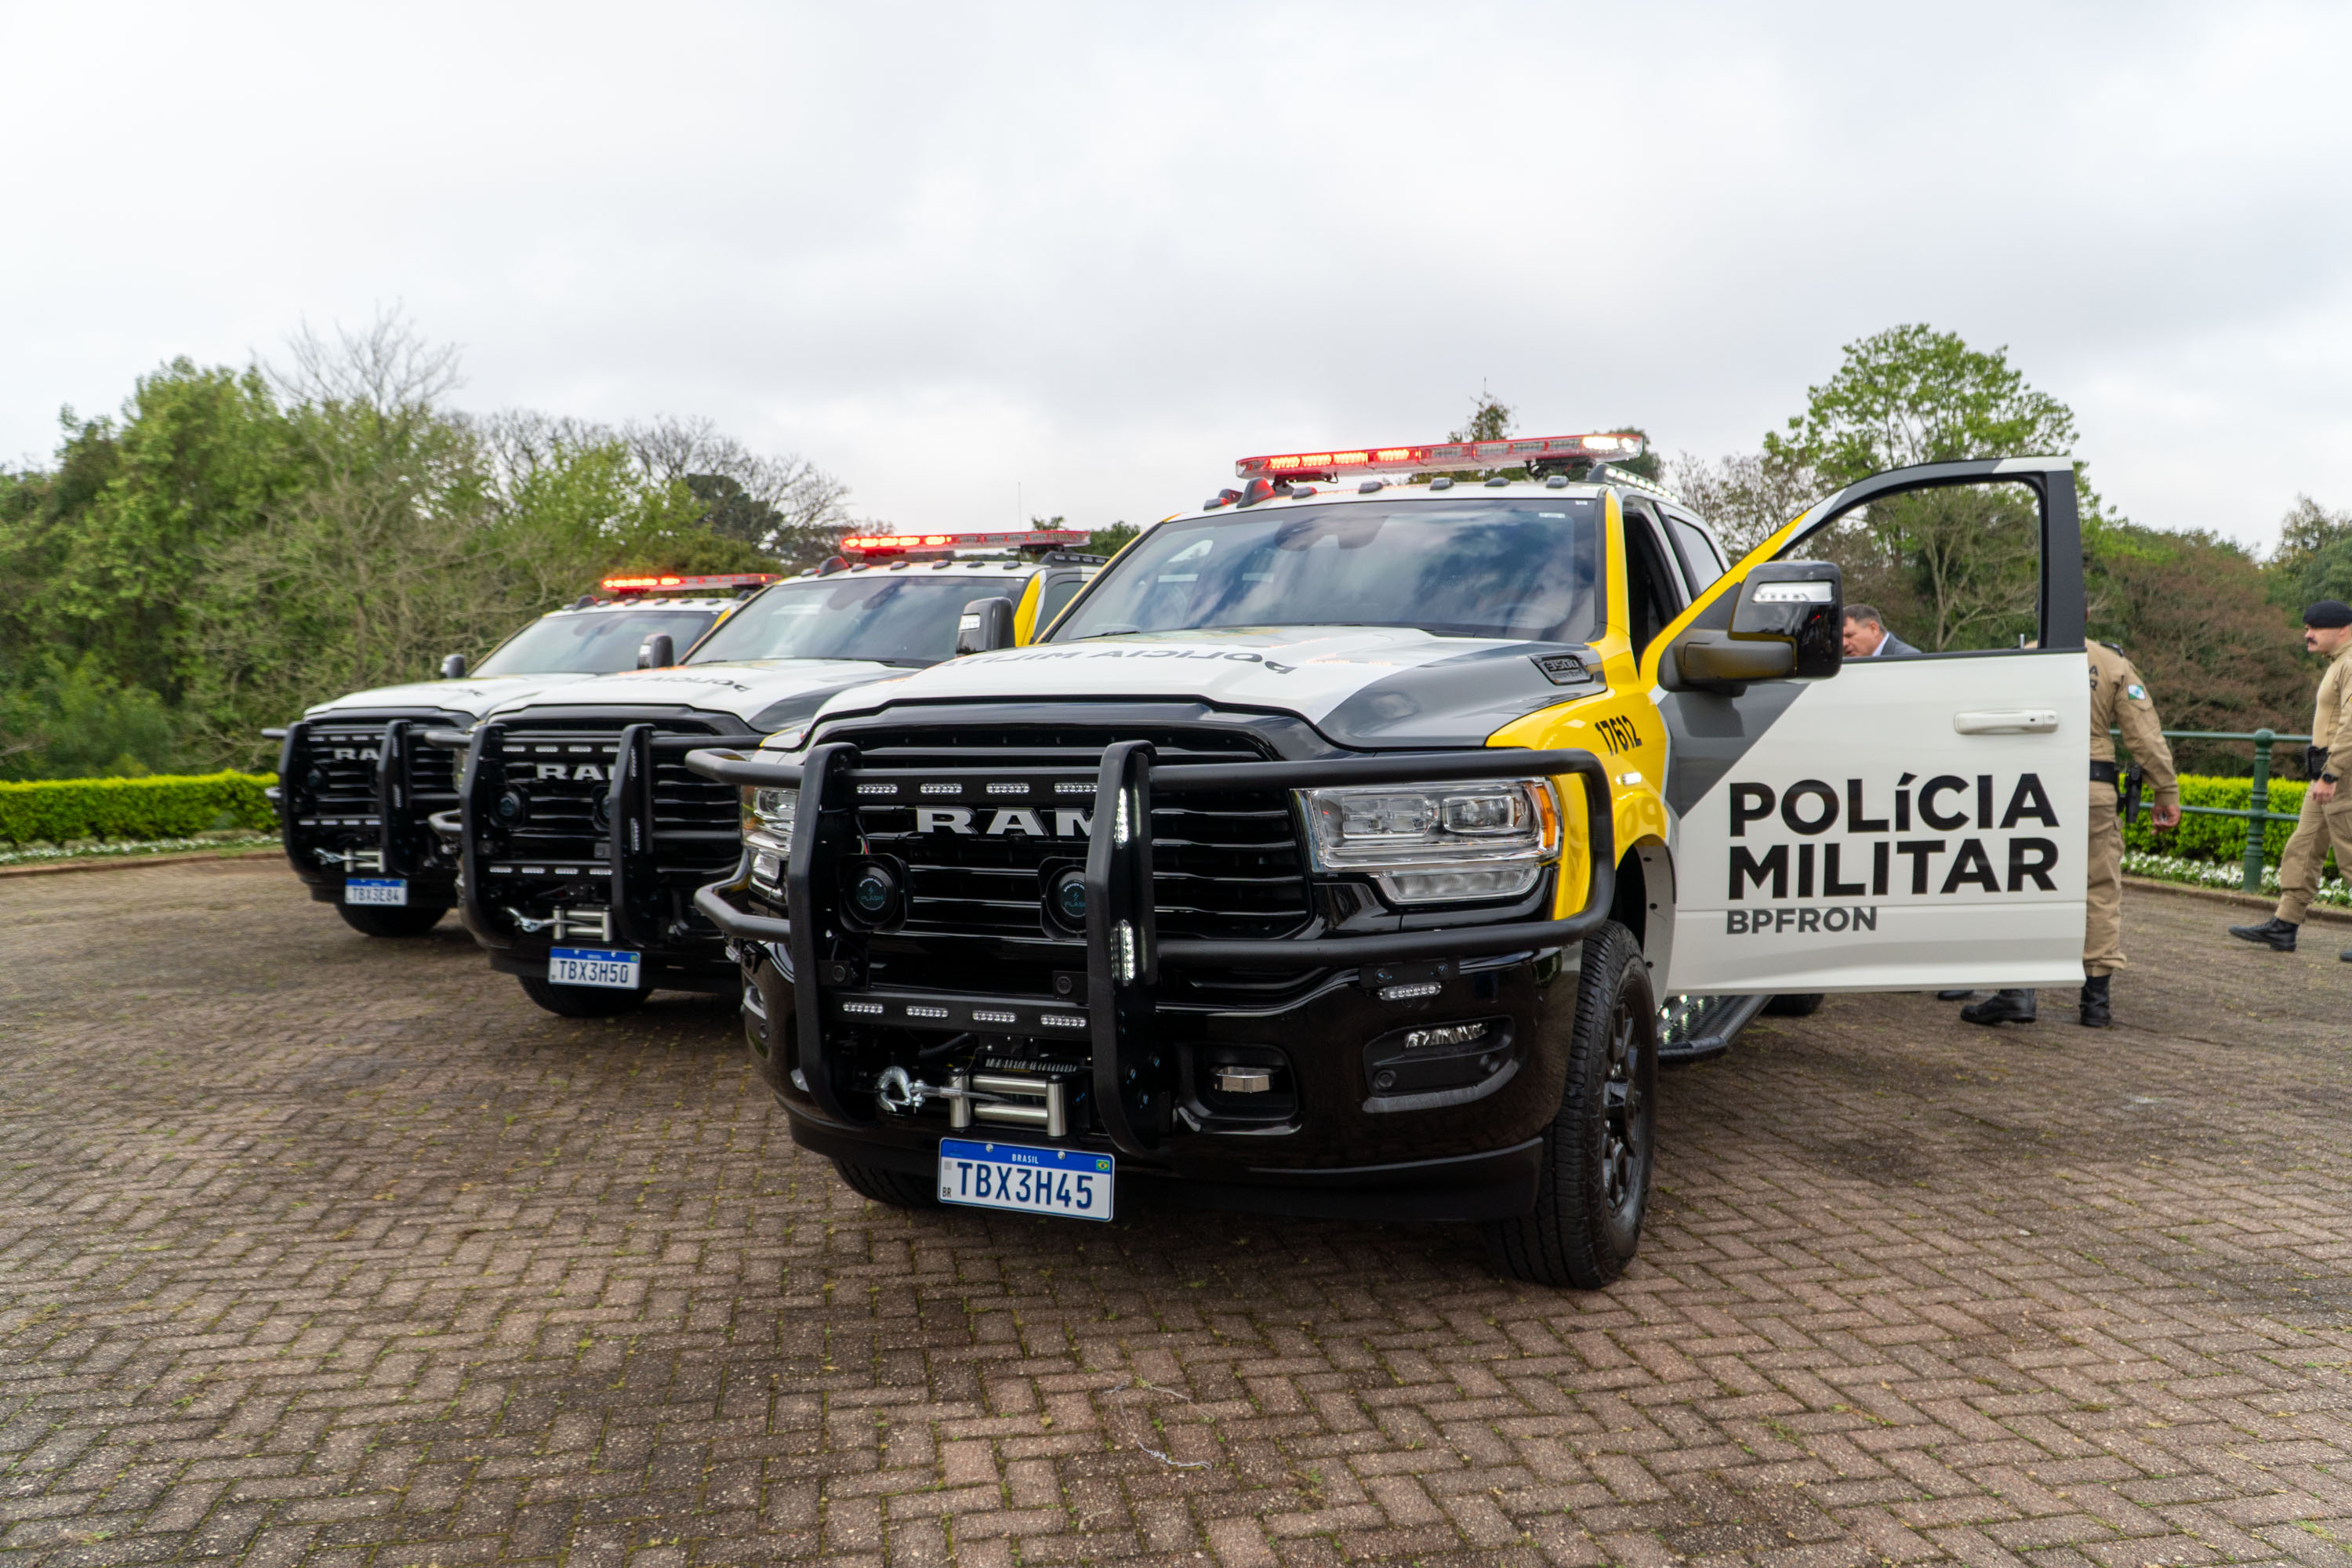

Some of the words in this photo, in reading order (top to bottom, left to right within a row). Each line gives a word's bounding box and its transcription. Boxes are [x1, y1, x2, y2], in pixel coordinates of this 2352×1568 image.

[1544, 659, 1579, 672] 3500
[1595, 715, 1642, 756] 17612
[334, 748, 379, 760] RA
[536, 764, 615, 780] RA
[1728, 837, 2060, 901] MILITAR
[1726, 907, 1877, 935] BPFRON
[559, 960, 628, 983] TBX3H50
[1011, 1153, 1039, 1164] BRASIL
[942, 1187, 952, 1198] BR
[956, 1162, 1093, 1209] TBX3H45
